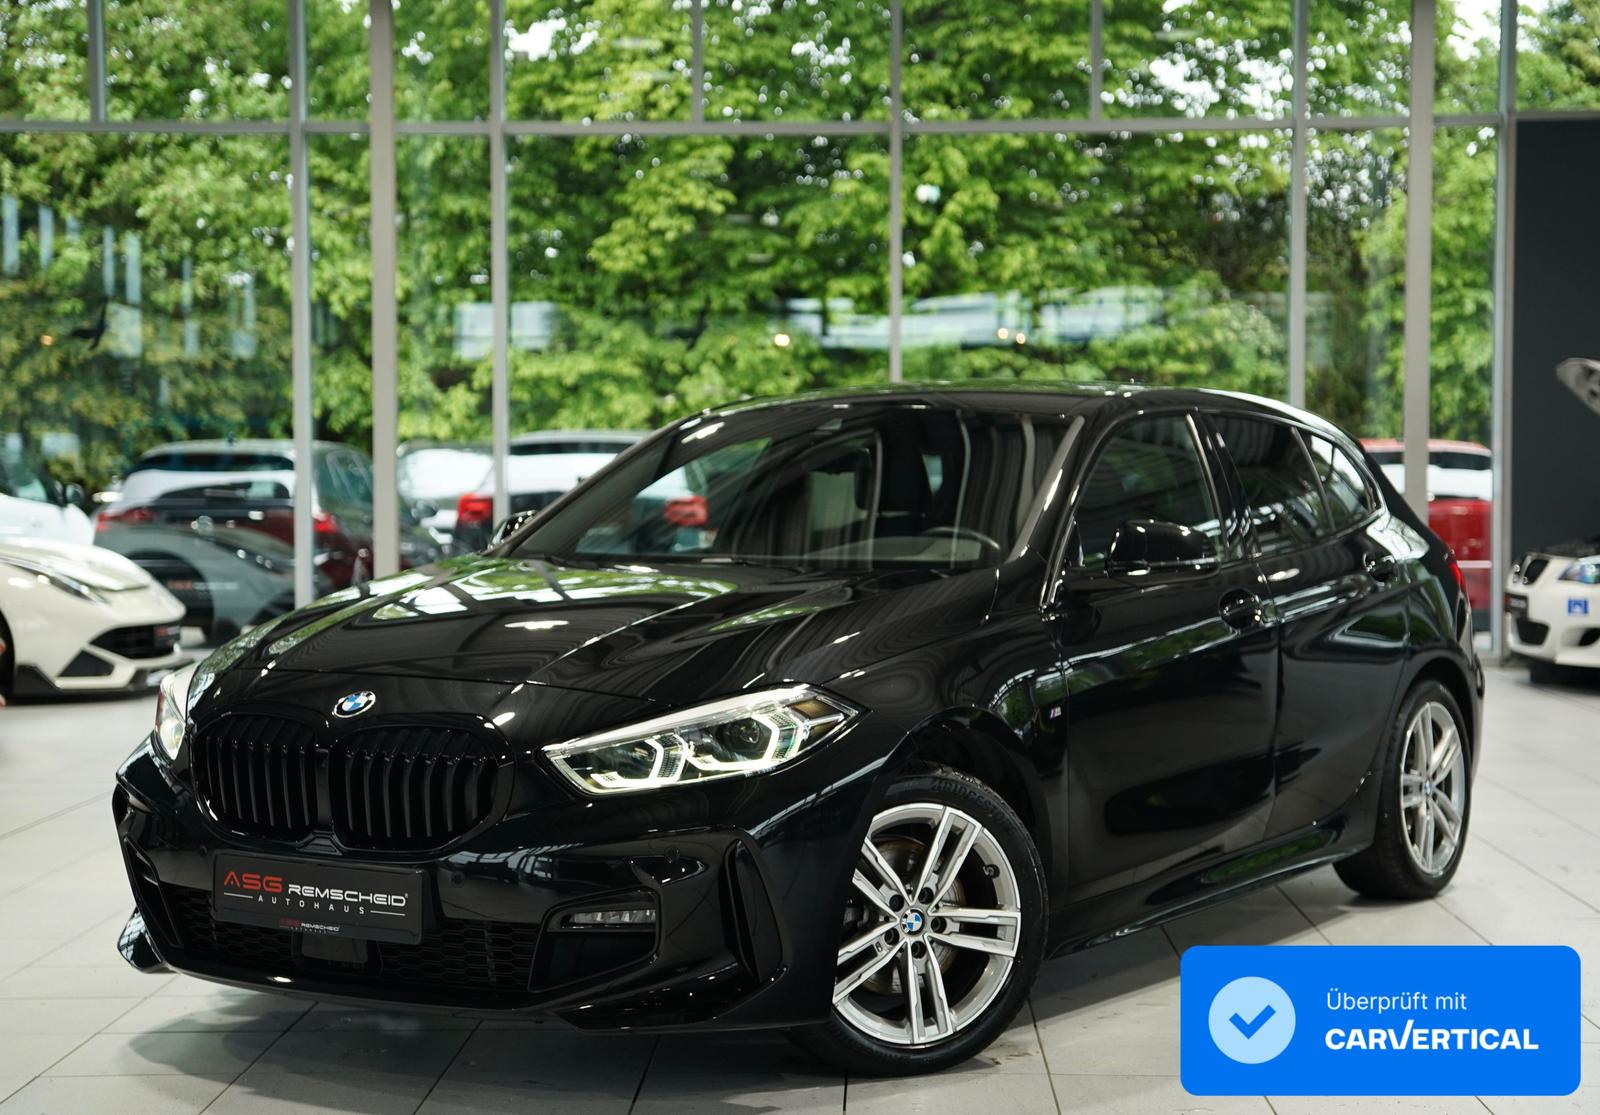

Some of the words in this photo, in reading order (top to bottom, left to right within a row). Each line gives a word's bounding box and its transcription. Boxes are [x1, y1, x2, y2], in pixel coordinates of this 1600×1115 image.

[223, 869, 283, 893] ASG
[288, 883, 406, 907] REMSCHEID
[258, 894, 365, 914] AUTOHAUS
